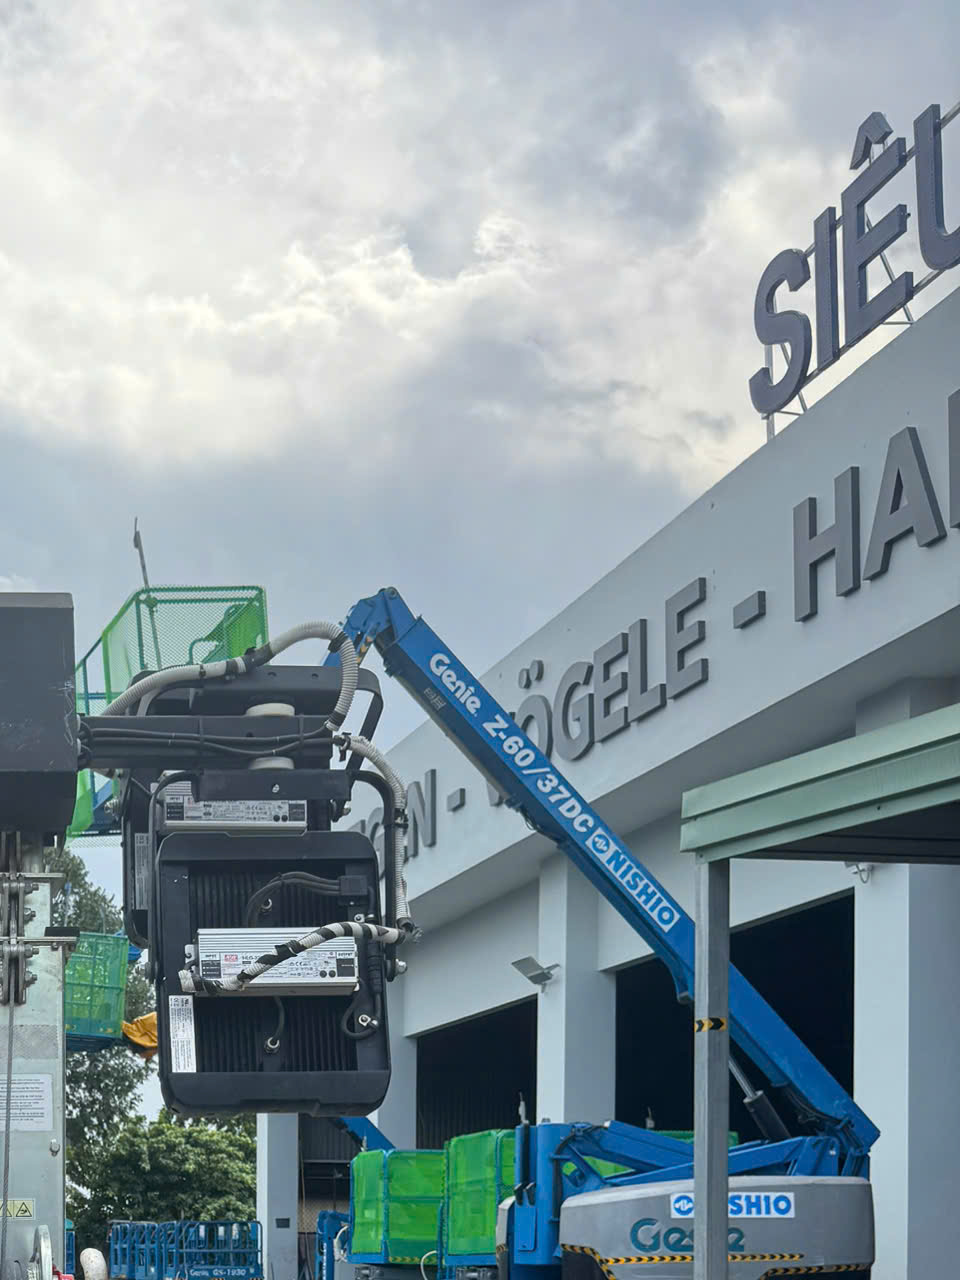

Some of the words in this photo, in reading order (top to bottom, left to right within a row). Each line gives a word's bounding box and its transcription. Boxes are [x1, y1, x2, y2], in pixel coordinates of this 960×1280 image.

[428, 653, 482, 715] Genie
[498, 577, 709, 775] ÖGELE
[605, 849, 676, 926] NISHIO
[630, 1217, 745, 1253] Gee
[728, 1194, 792, 1216] SHIO
